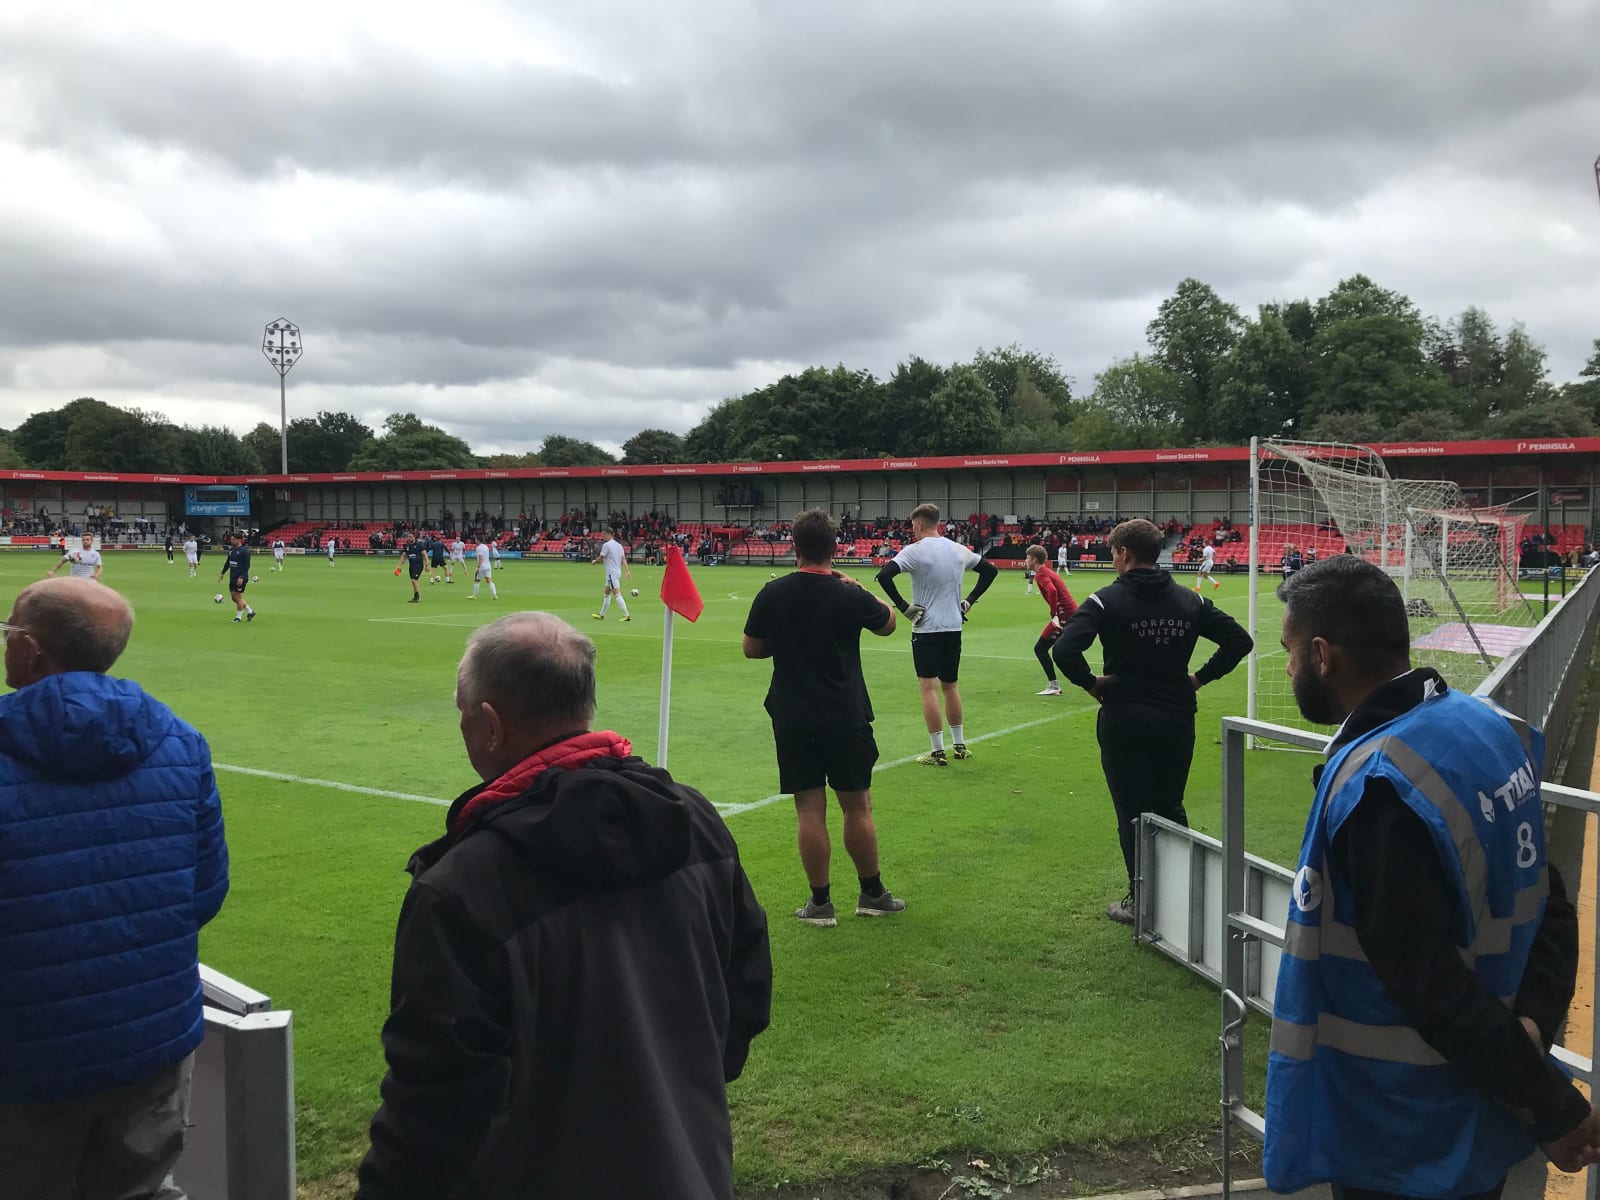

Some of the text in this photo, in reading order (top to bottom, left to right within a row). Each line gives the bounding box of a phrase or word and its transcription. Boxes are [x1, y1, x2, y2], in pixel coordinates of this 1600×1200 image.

[1529, 443, 1576, 451] PENINSULA
[1068, 455, 1101, 463] PENINSULA
[1131, 619, 1191, 630] NORFORD
[1138, 628, 1185, 637] UNITED
[1155, 637, 1170, 645] FC
[1517, 821, 1537, 868] 8
